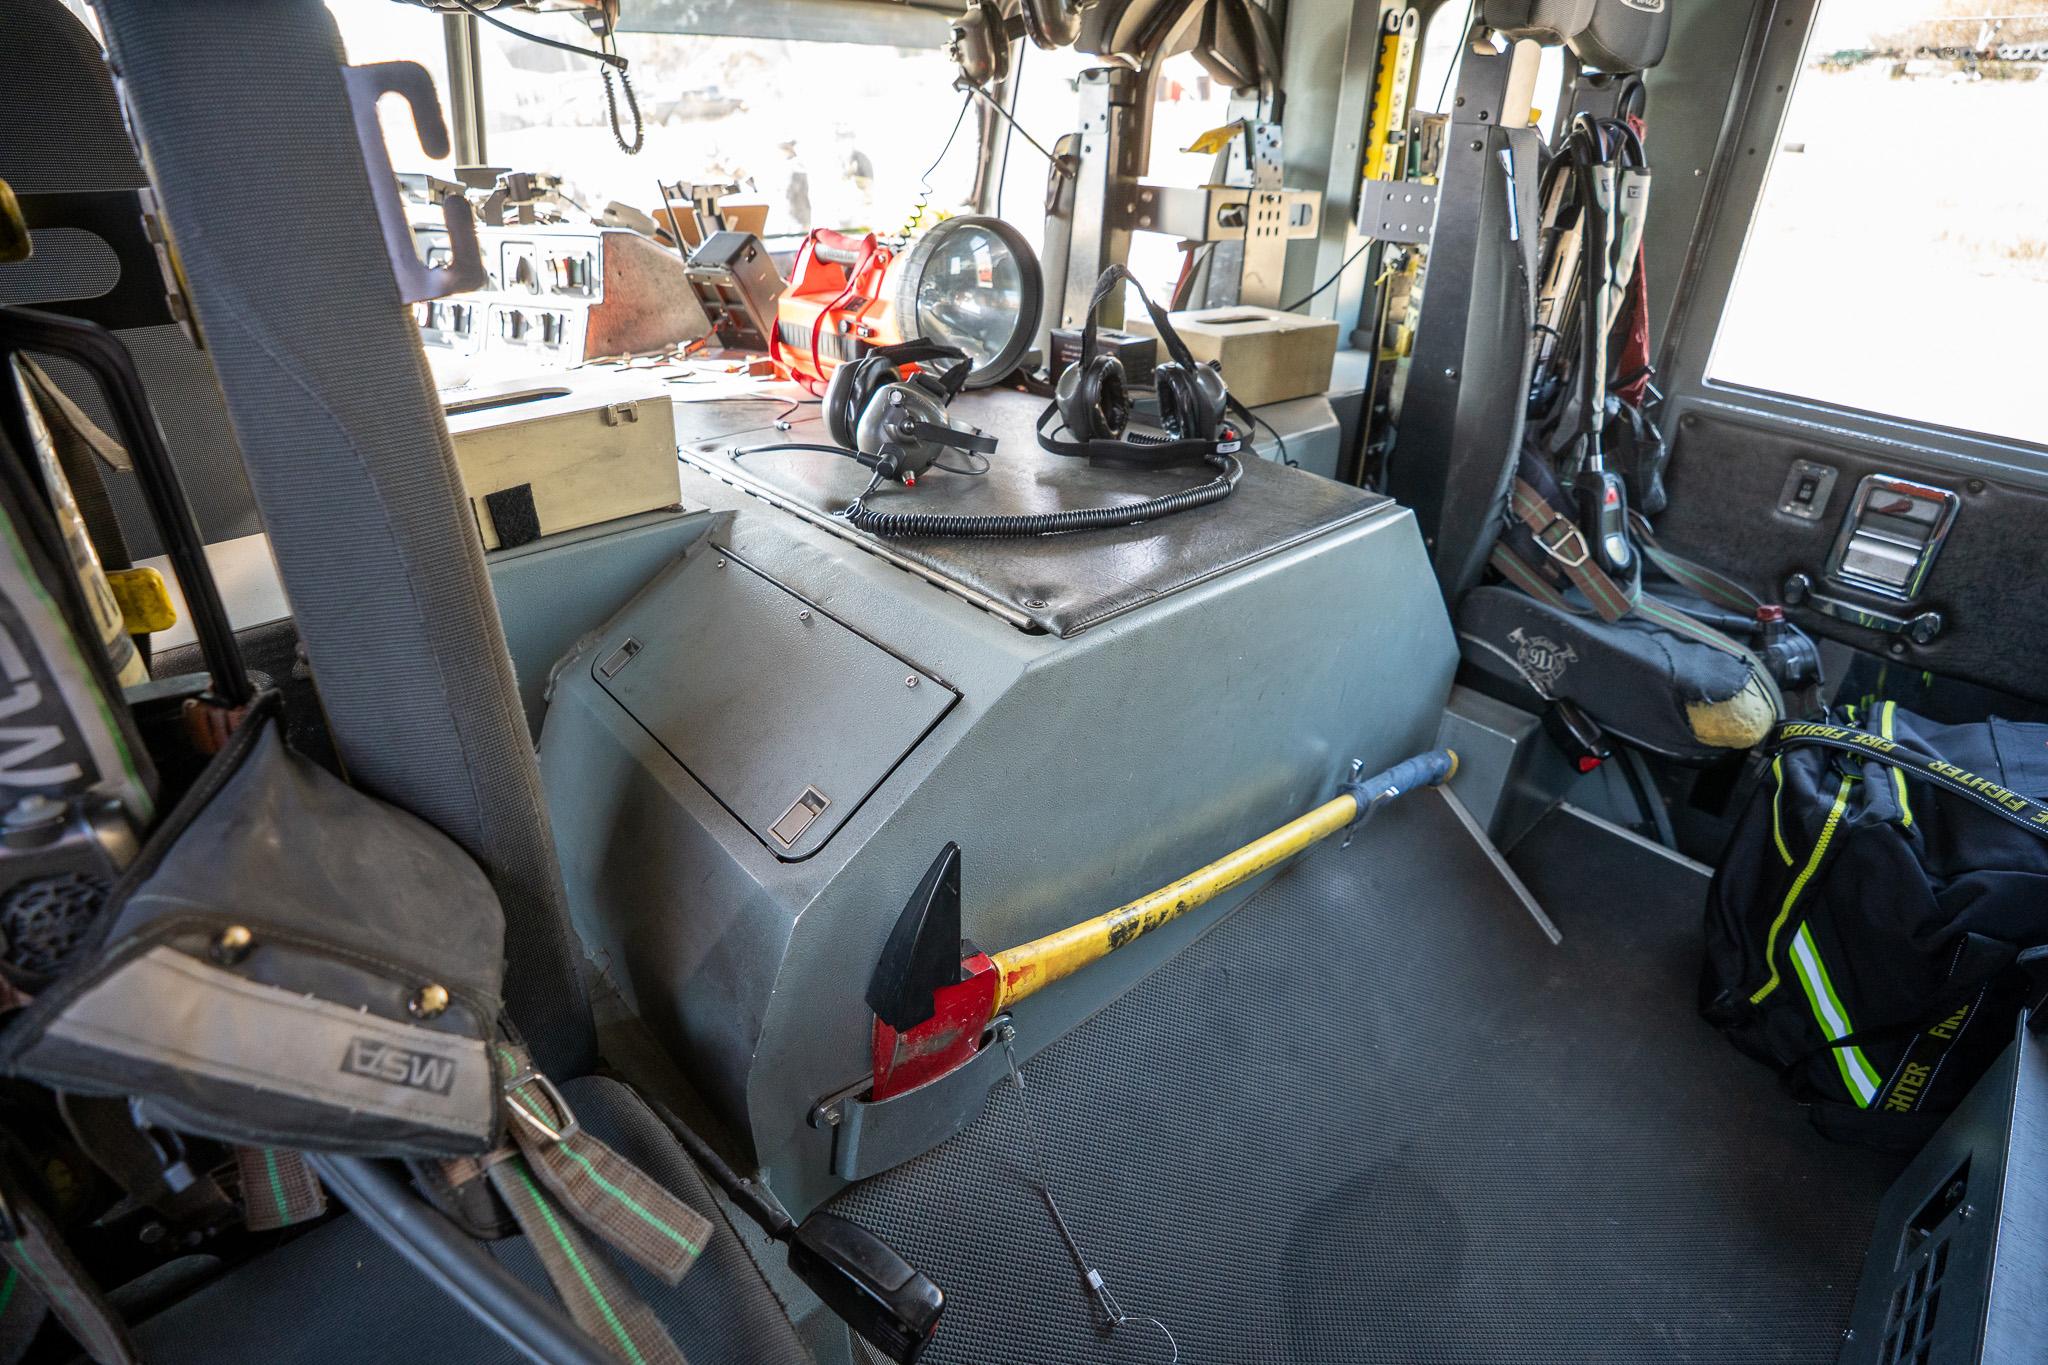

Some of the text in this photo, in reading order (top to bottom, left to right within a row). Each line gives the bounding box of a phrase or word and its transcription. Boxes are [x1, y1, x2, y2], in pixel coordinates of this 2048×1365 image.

[1529, 648, 1553, 670] 911
[1779, 724, 2028, 812] FIGHTER FIRE FIGHTER
[351, 1038, 451, 1091] MSA
